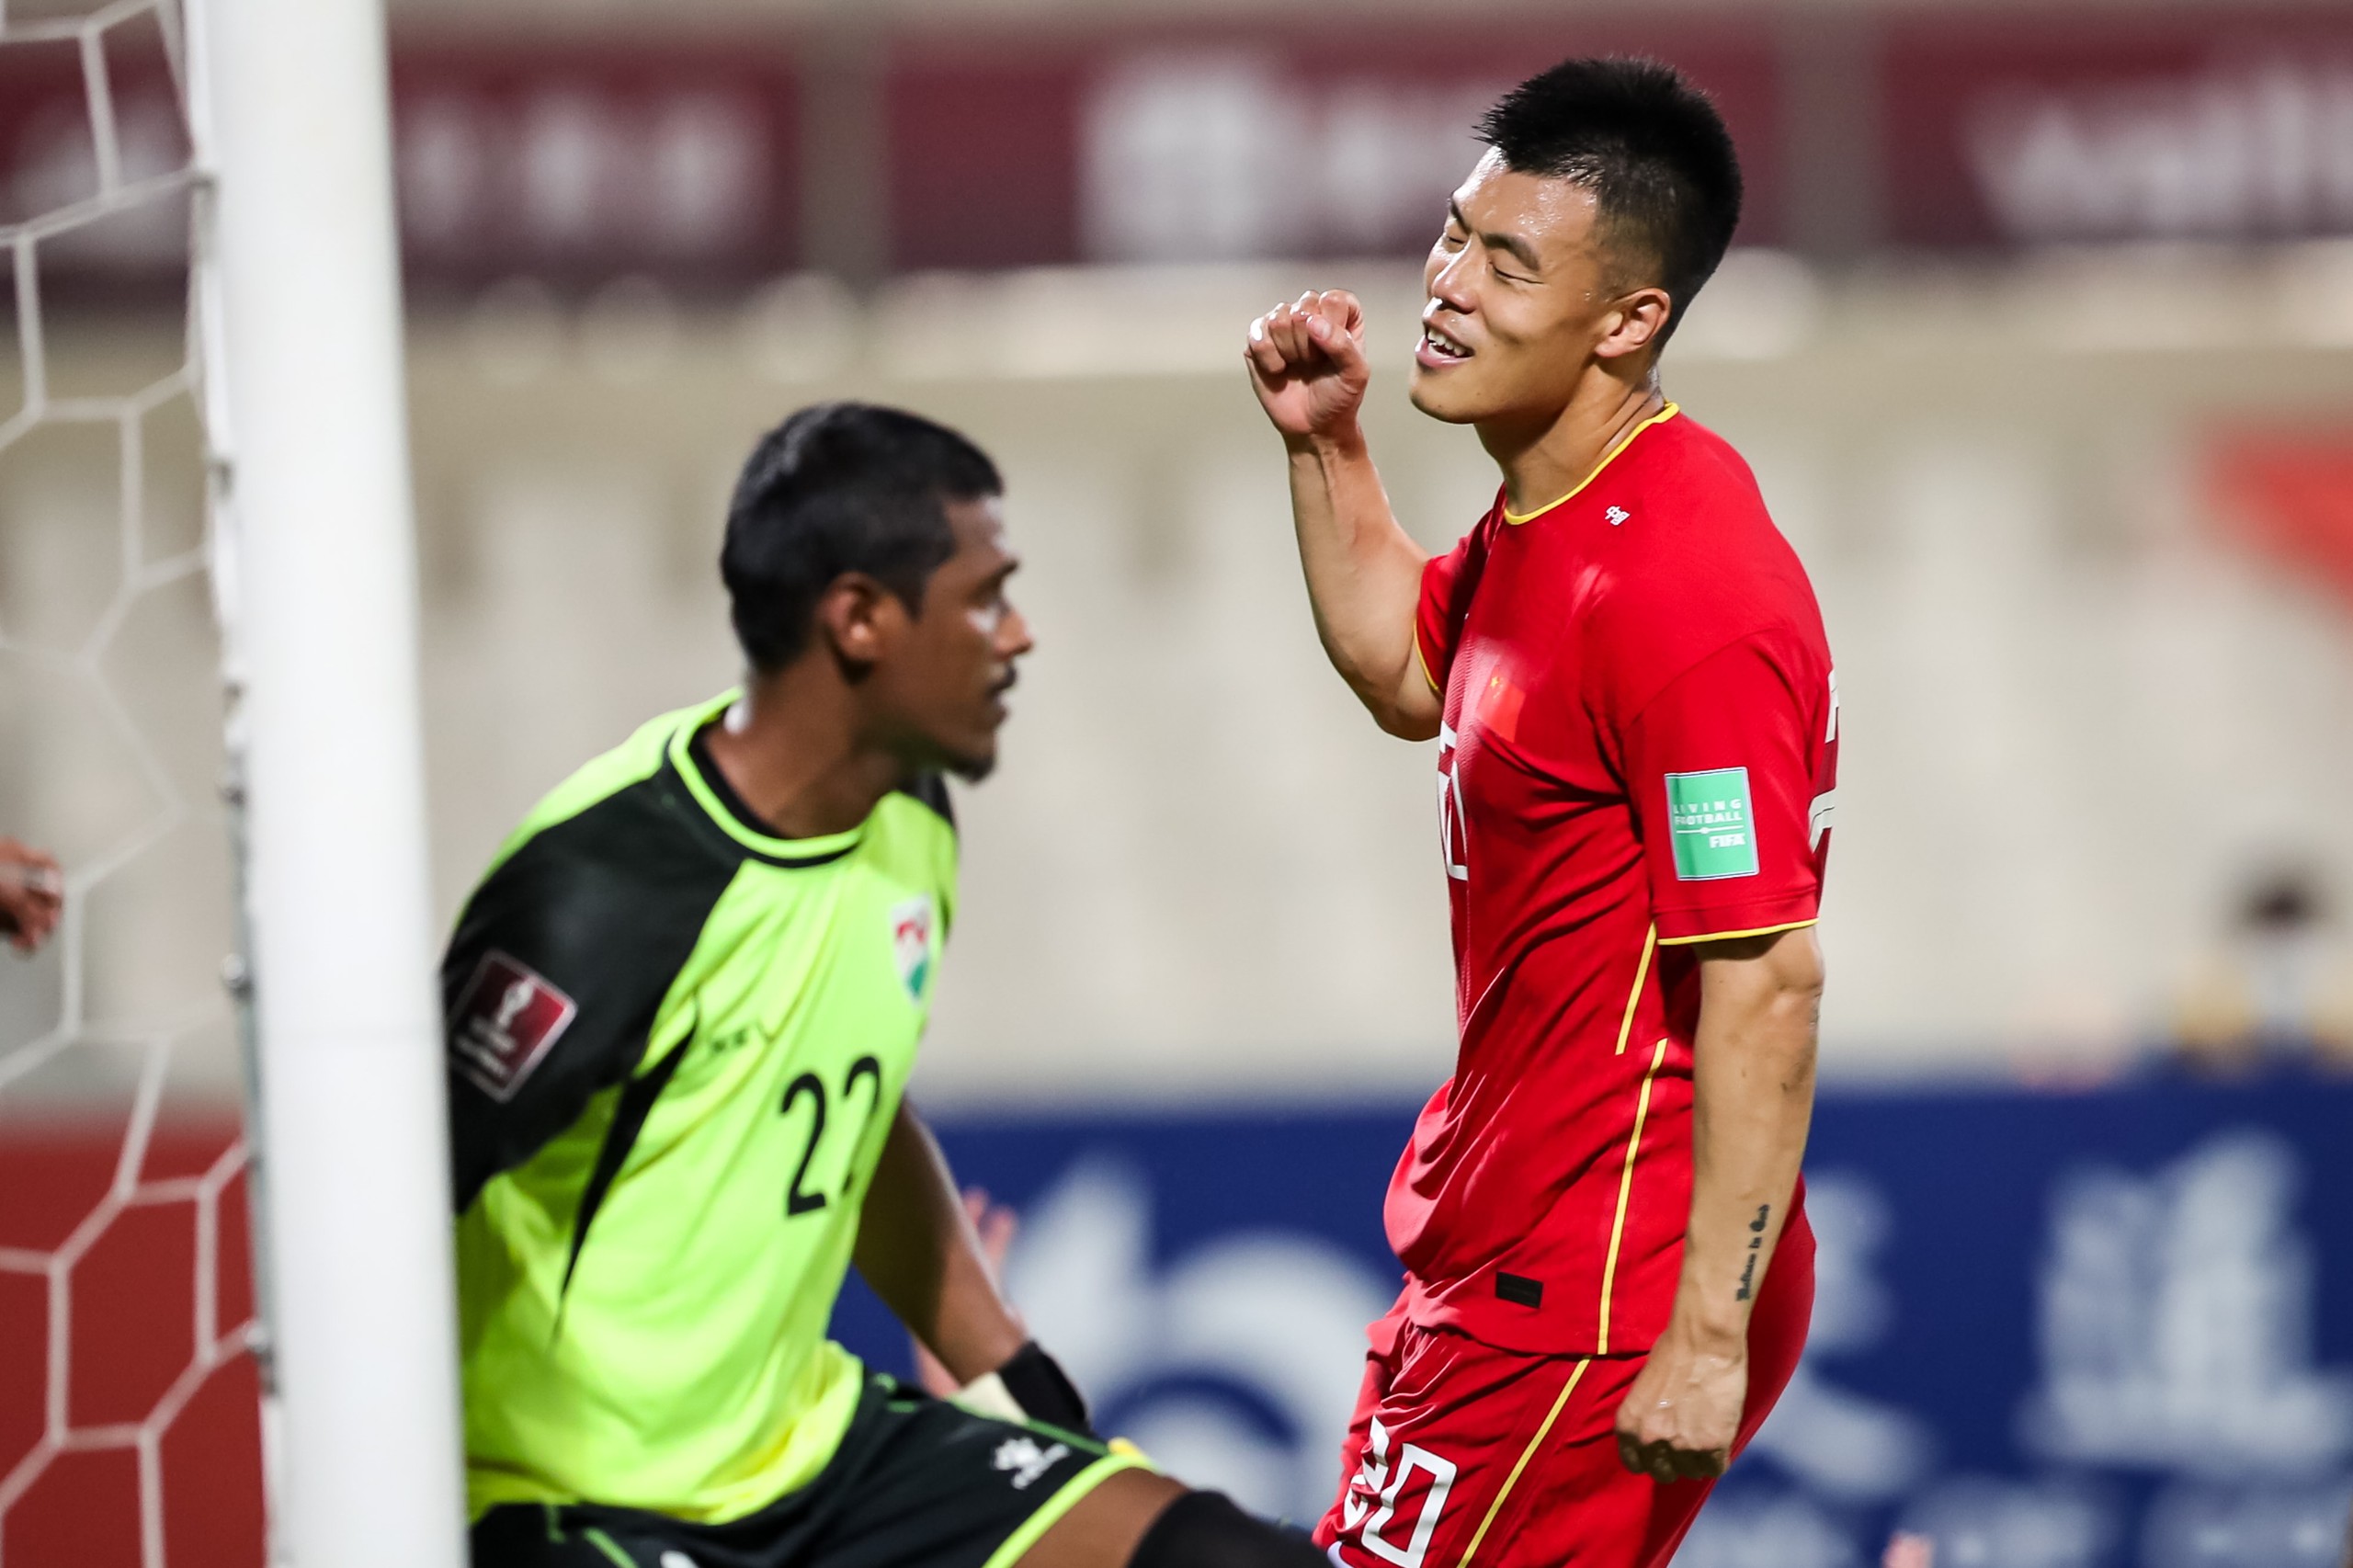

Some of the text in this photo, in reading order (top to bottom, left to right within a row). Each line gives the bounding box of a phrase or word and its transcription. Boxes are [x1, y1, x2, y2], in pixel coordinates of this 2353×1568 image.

[1673, 799, 1743, 814] LIVING
[1674, 811, 1743, 824] FOOTBALL
[1709, 833, 1745, 848] FIFA
[781, 1054, 881, 1216] 22
